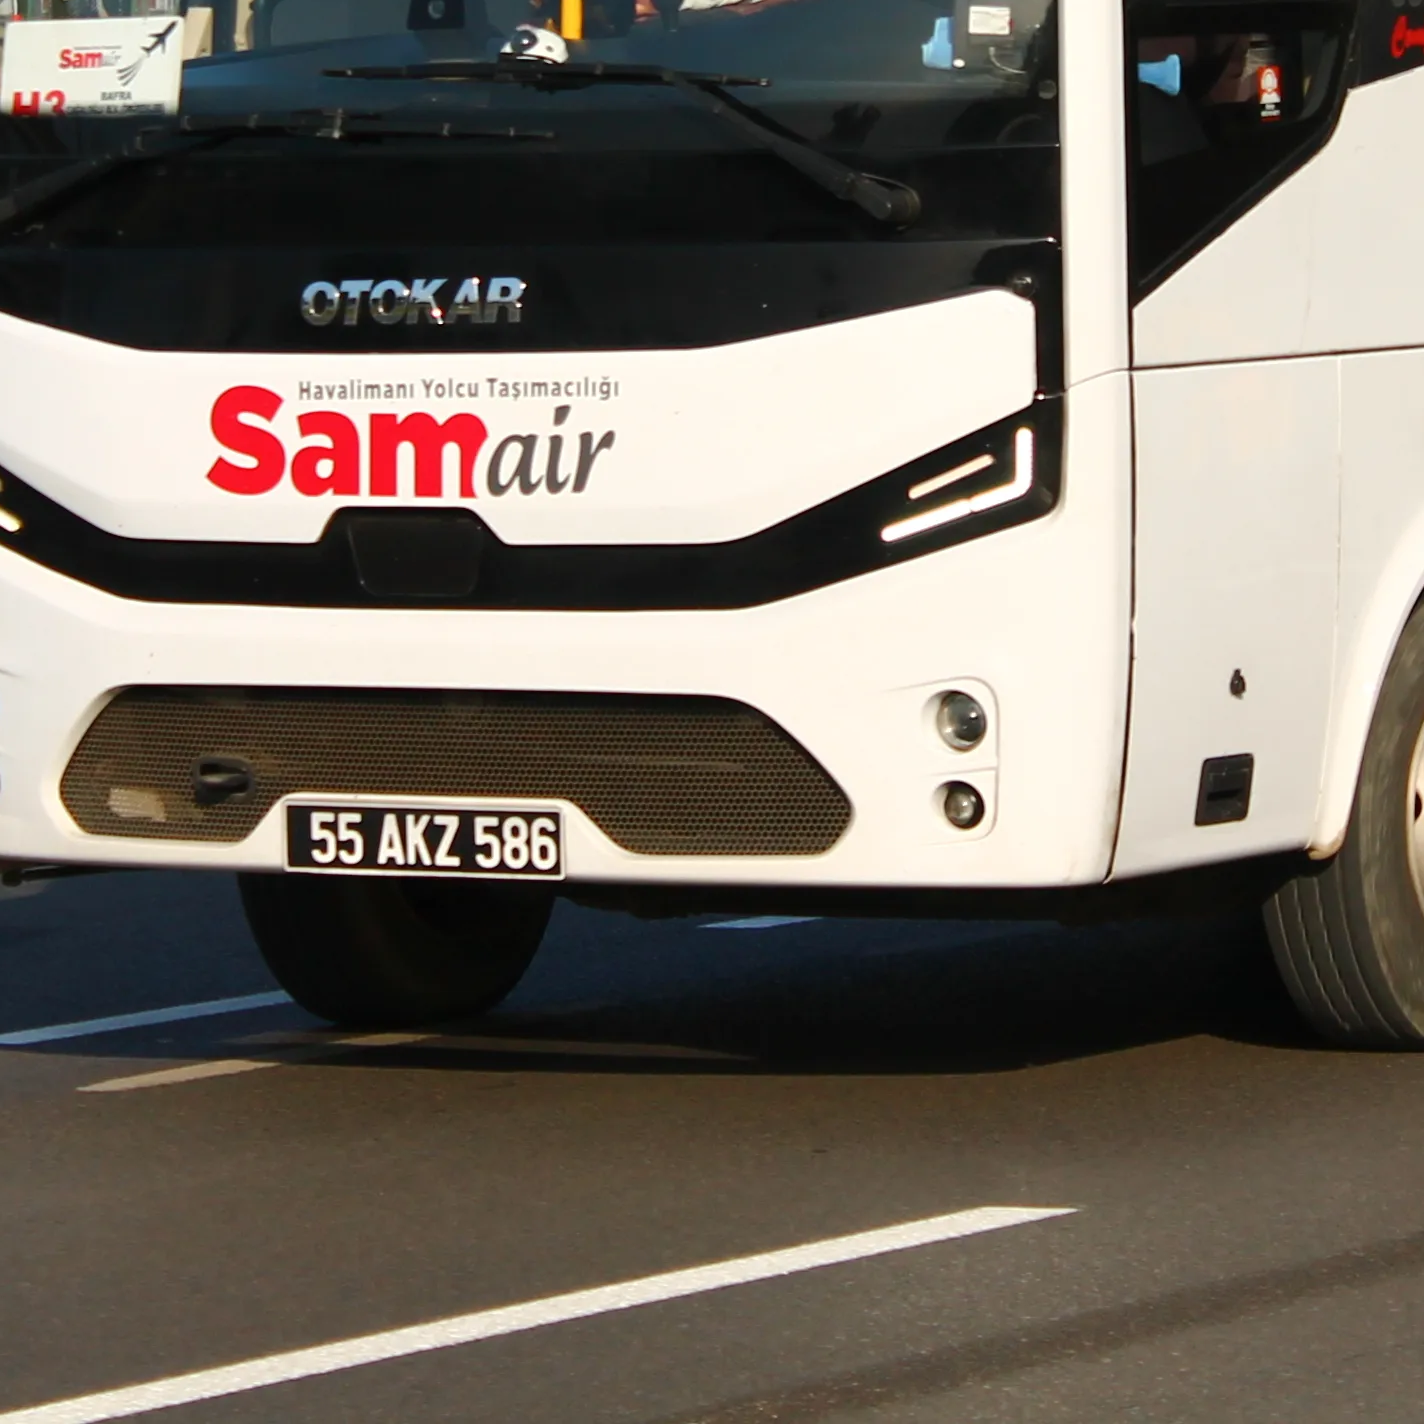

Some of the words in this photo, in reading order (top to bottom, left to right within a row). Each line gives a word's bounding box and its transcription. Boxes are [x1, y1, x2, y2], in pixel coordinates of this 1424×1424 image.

[300, 276, 527, 326] OTOKAR
[298, 379, 414, 400] Havalimanı
[421, 378, 479, 399] Yolcu
[486, 376, 619, 401] Taşımacılığı
[206, 385, 615, 498] Samair
[310, 812, 364, 864] 55
[377, 813, 461, 867] AKZ
[474, 816, 557, 870] 586
